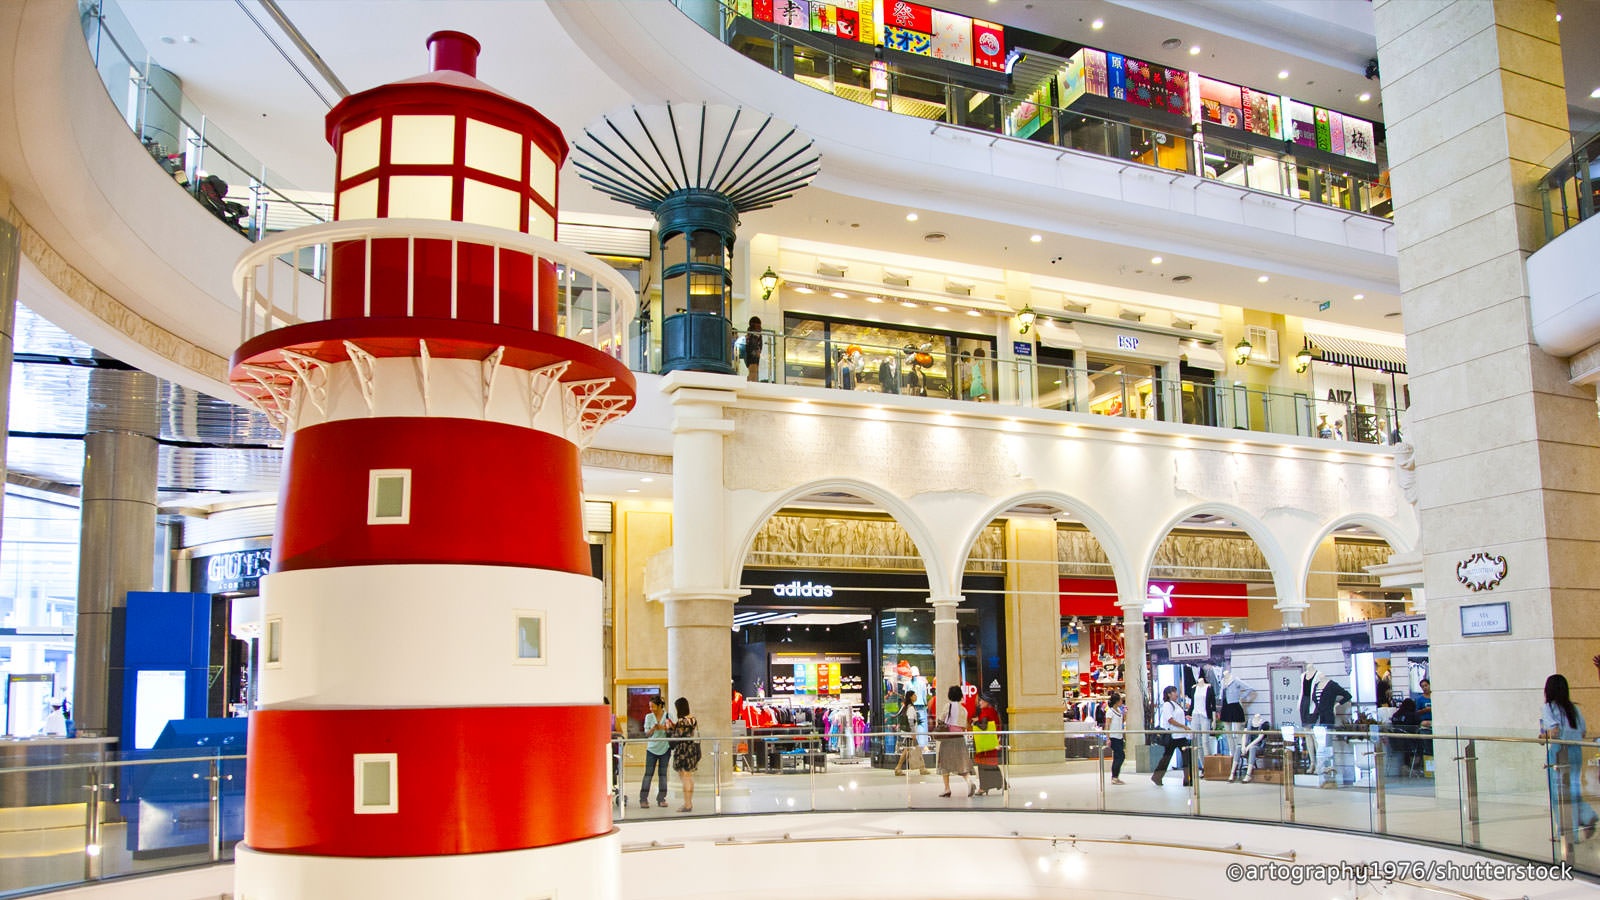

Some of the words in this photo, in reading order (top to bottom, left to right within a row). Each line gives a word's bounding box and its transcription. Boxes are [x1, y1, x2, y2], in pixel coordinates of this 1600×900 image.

[1118, 335, 1139, 350] ESP
[773, 581, 833, 598] adidas
[1384, 623, 1420, 640] LME
[1177, 642, 1201, 655] LME
